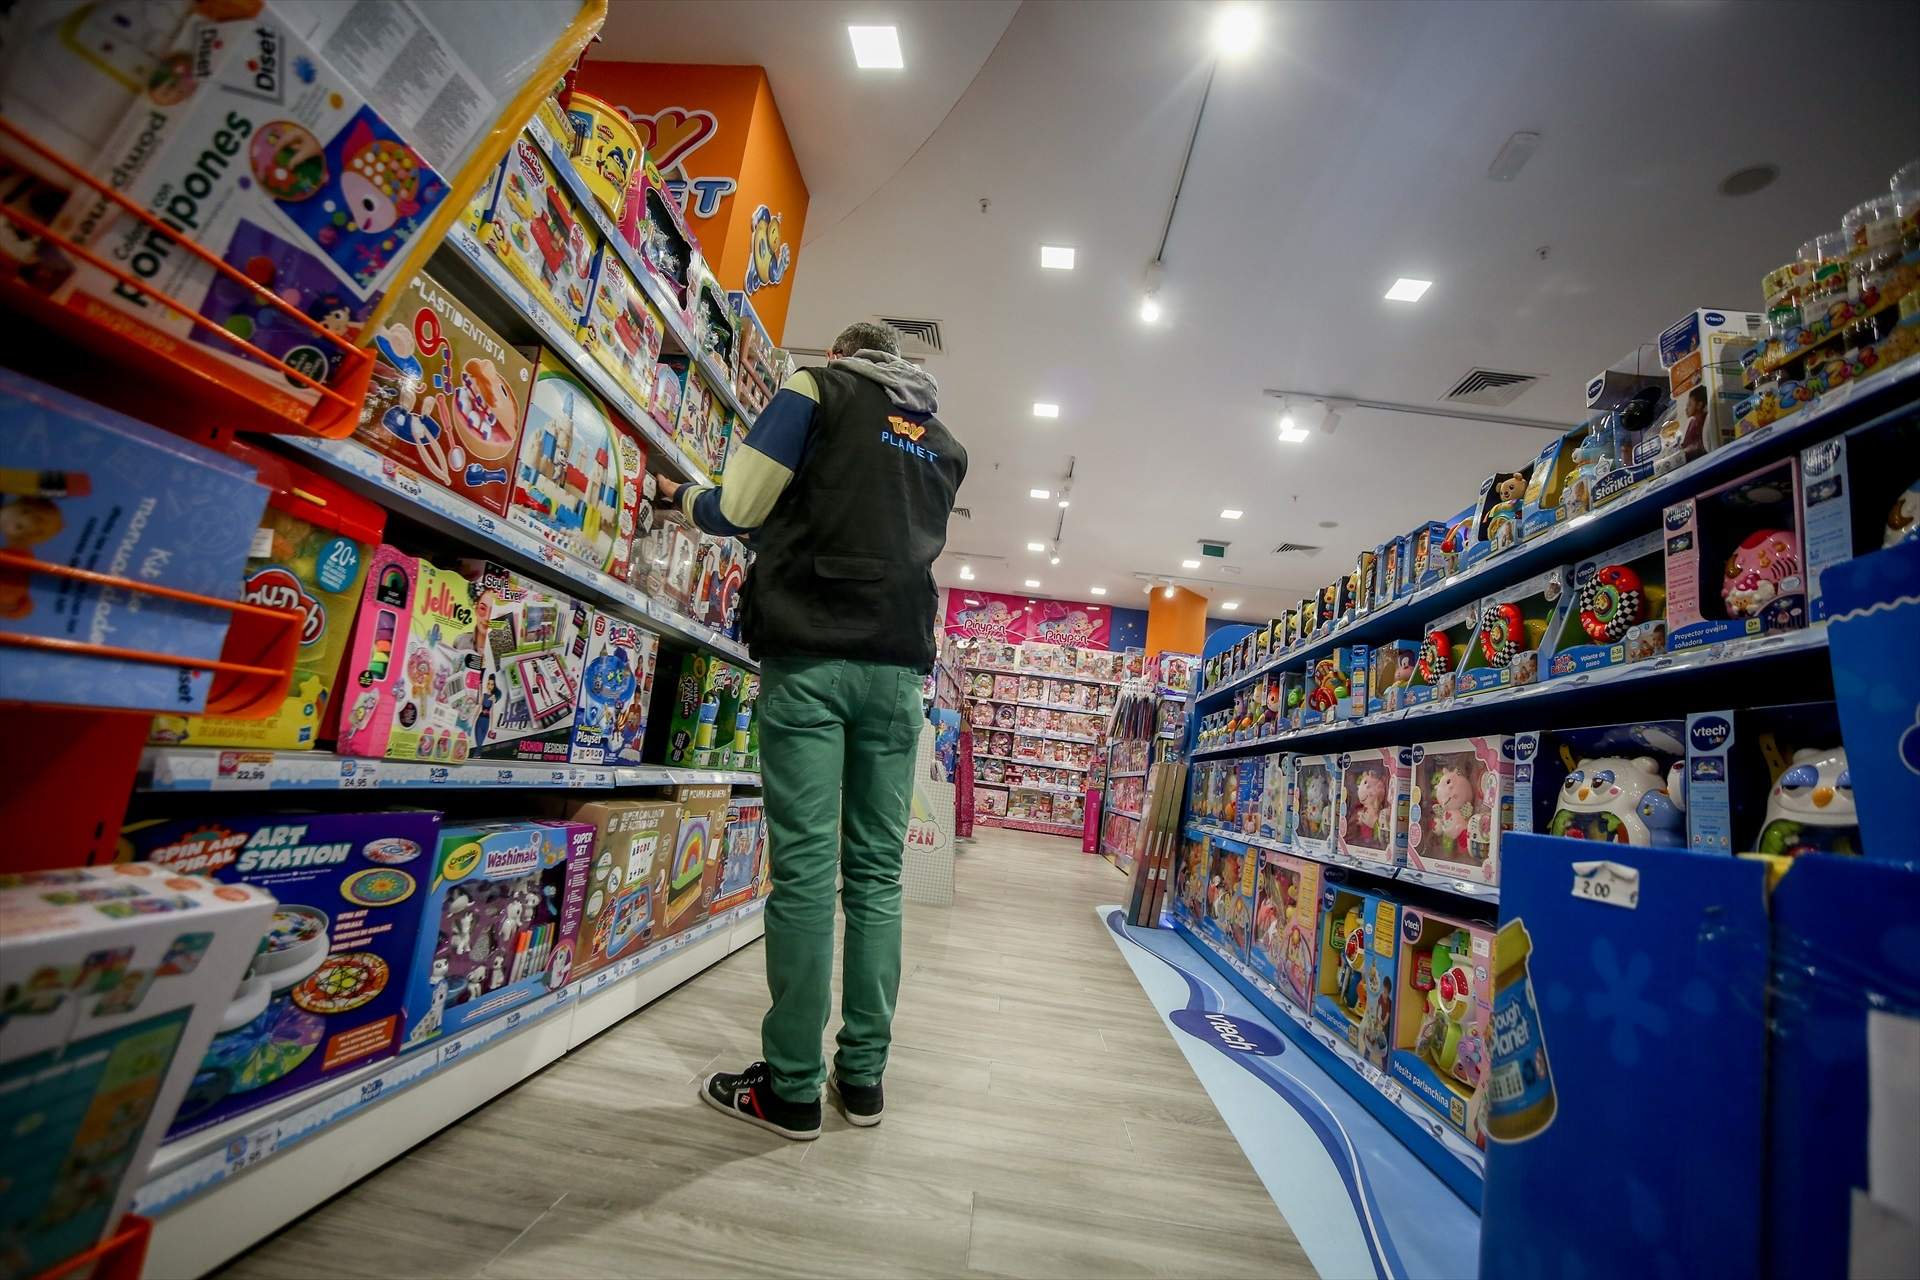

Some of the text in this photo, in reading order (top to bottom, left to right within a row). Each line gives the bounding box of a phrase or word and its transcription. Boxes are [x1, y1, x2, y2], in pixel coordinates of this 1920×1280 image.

[256, 27, 276, 92] Diset
[409, 276, 506, 364] PLASTIDENTISTA
[888, 415, 926, 441] TOY
[881, 431, 939, 462] PLANET
[1596, 473, 1634, 500] StoriKid
[140, 547, 173, 578] Kit
[330, 541, 356, 567] 20+
[964, 618, 1006, 639] Pinypon
[1044, 630, 1089, 648] Pinypon
[1674, 629, 1705, 642] Proyector
[1674, 638, 1703, 650] soñadora
[1693, 724, 1726, 738] vtech
[544, 742, 569, 754] DESIGNER
[1517, 740, 1534, 751] vtech
[150, 833, 249, 863] SPIN AND
[243, 825, 309, 849] ART
[908, 831, 935, 846] FAN
[235, 842, 354, 873] STATION
[487, 847, 538, 869] Washimals
[1403, 918, 1420, 931] vtech
[1205, 1014, 1258, 1051] vtech
[1393, 1060, 1449, 1109] Mesita parlanchina
